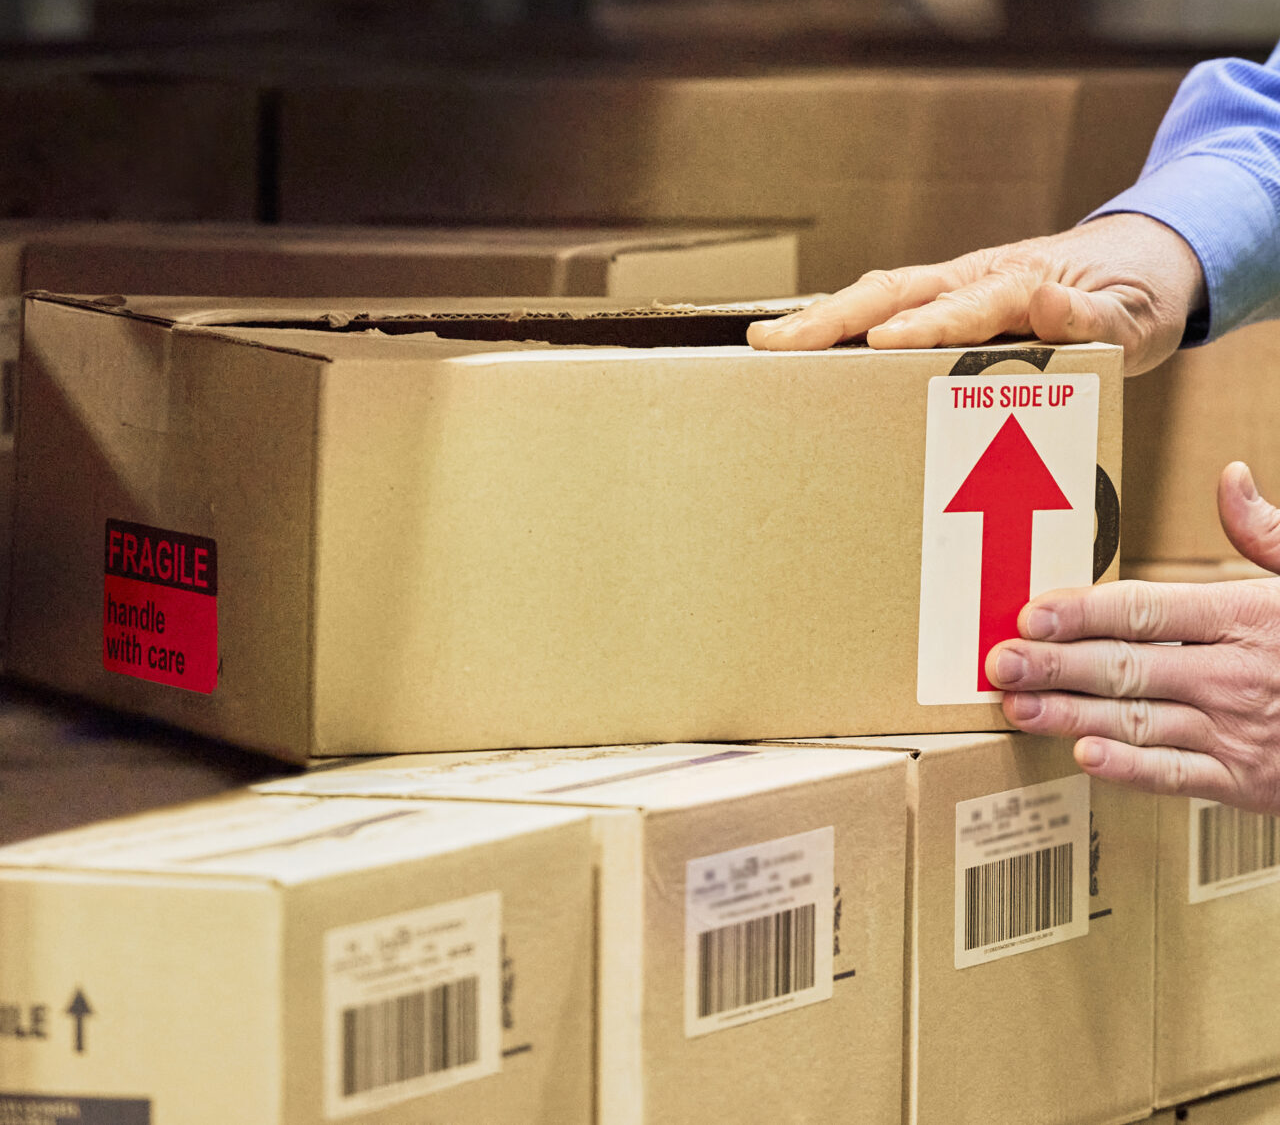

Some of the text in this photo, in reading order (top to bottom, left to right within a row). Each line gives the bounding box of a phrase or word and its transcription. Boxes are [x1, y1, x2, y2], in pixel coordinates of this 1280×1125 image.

[951, 385, 1074, 408] THIS SIDE UP
[108, 530, 209, 588] FRAGILE
[107, 593, 166, 634] handle
[106, 632, 142, 666] with
[147, 646, 185, 675] care
